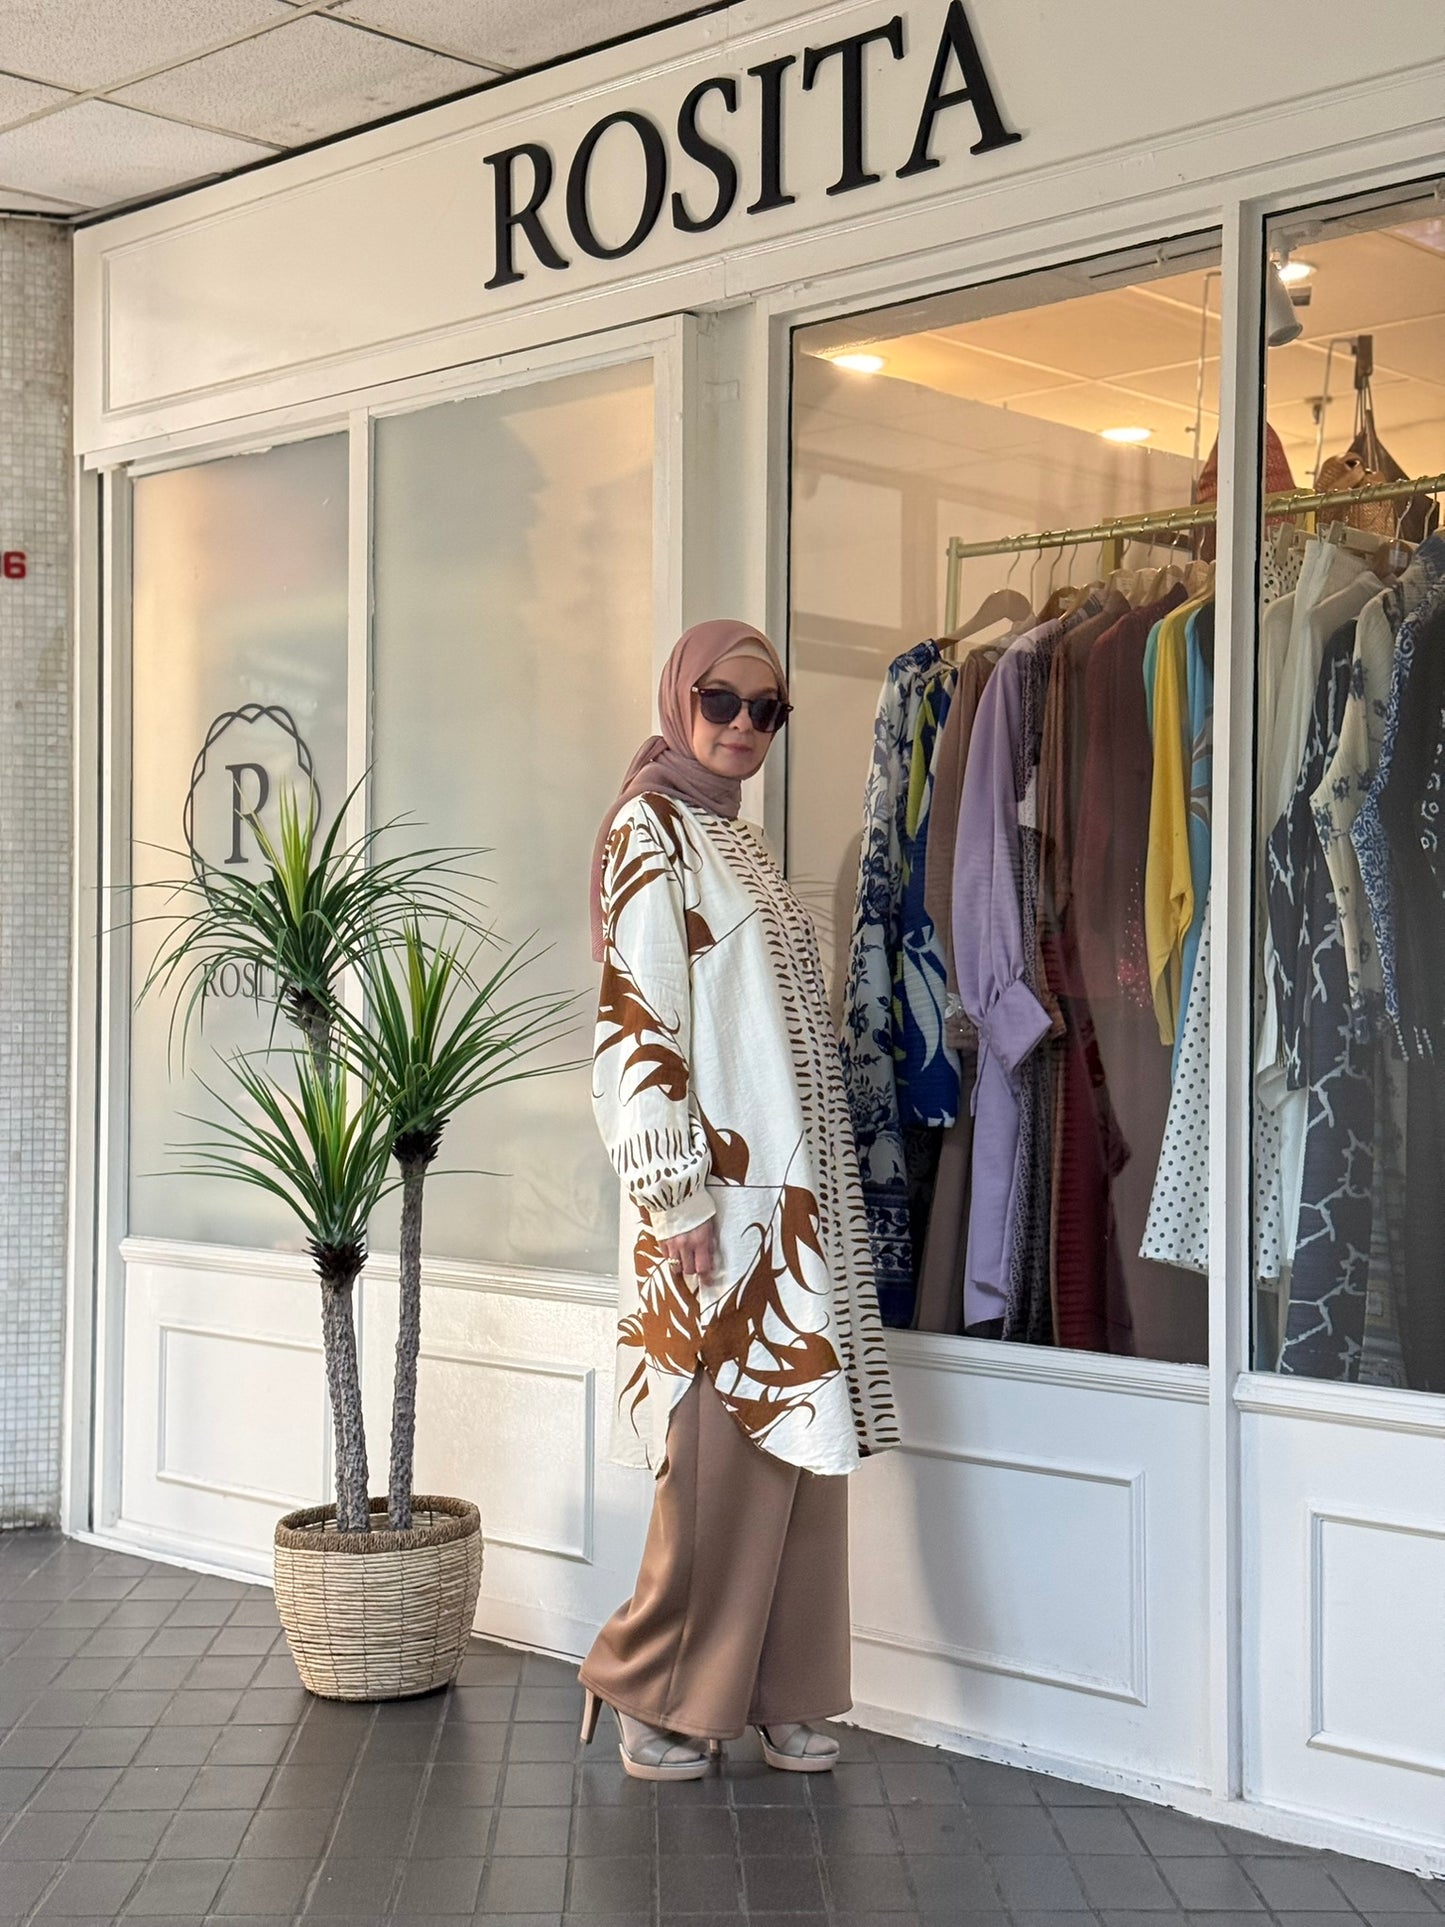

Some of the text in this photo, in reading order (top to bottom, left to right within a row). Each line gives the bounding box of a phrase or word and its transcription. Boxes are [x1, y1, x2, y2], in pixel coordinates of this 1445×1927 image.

[483, 0, 1021, 290] ROSITA
[0, 551, 26, 579] 6
[224, 762, 270, 865] R
